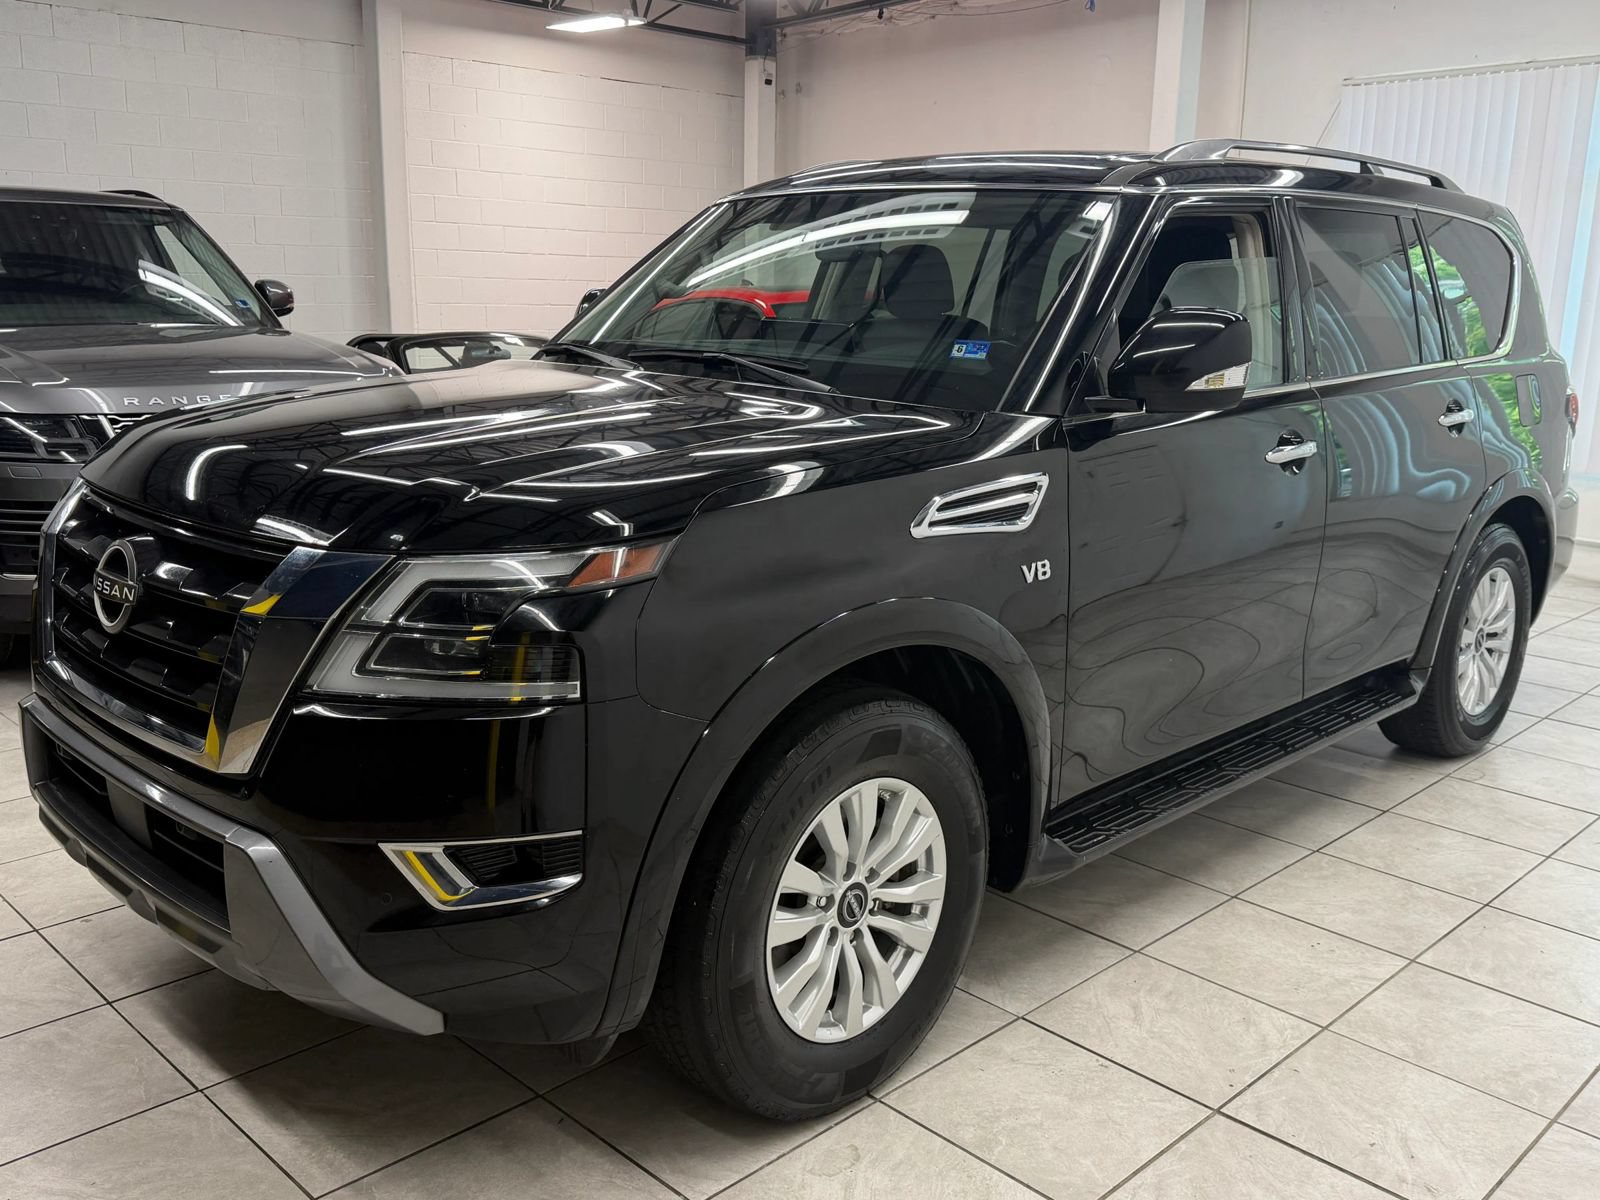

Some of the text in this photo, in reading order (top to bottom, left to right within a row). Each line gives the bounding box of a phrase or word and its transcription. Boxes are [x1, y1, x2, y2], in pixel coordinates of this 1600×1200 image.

[123, 394, 231, 406] RANGE
[1021, 559, 1051, 584] V8
[96, 577, 135, 601] SSAN
